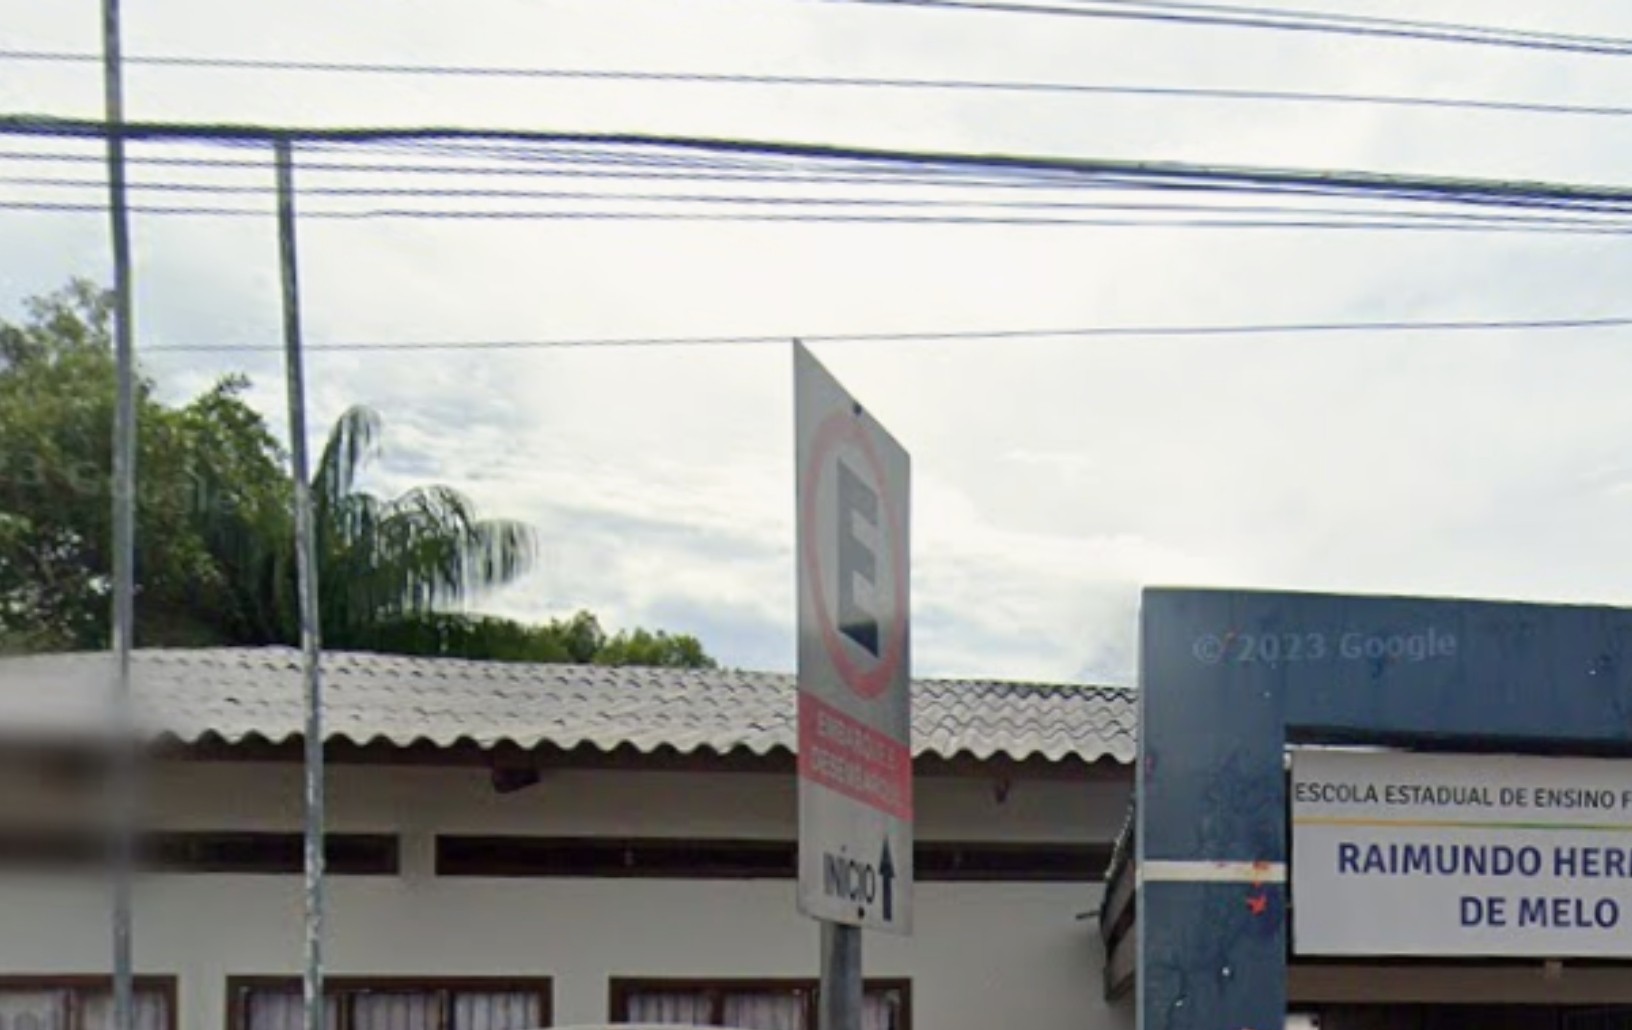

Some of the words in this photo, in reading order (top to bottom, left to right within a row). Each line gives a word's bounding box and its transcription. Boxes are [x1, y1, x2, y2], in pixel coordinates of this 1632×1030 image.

[836, 457, 879, 659] E
[1294, 781, 1379, 804] ESCOLA
[1384, 784, 1494, 807] ESTADUAL
[1499, 787, 1528, 808] DE
[1534, 787, 1616, 810] ENSINO
[1338, 842, 1542, 877] RAIMUNDO
[1459, 895, 1507, 928] DE
[1517, 896, 1620, 929] MELO
